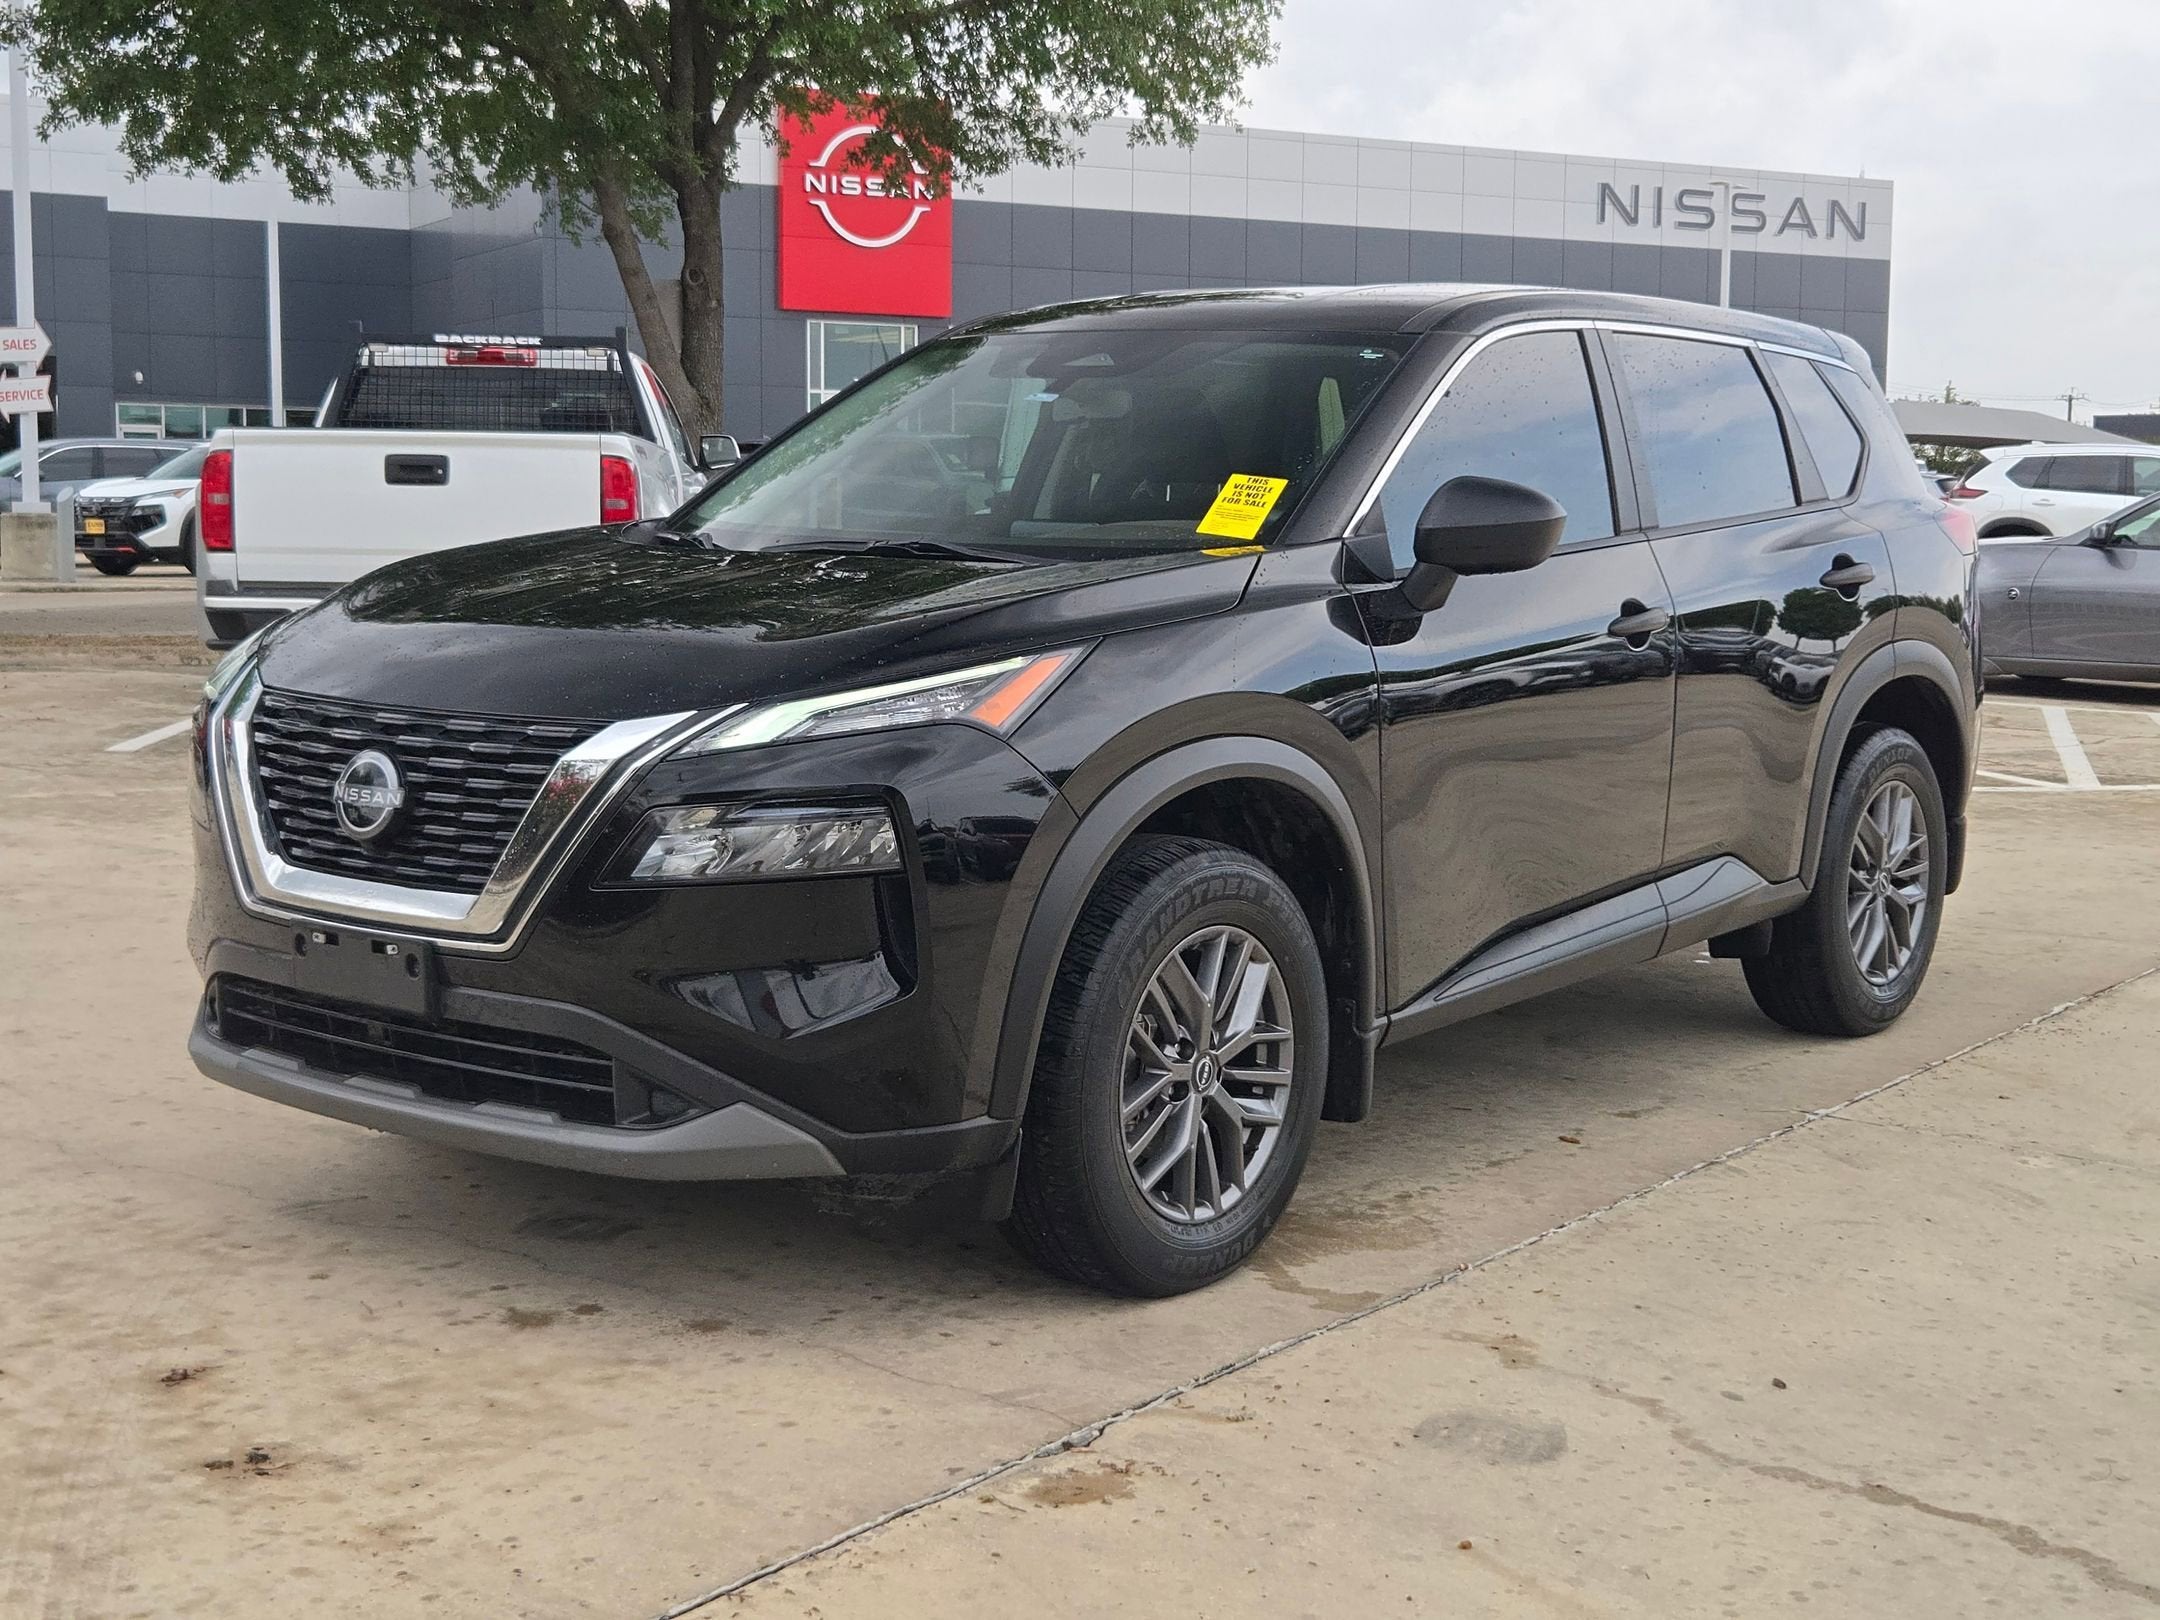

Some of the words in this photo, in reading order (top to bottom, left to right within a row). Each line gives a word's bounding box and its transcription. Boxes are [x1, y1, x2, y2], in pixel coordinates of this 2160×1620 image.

[1597, 181, 1867, 242] NISSAN
[2, 339, 37, 351] SALES
[434, 334, 543, 345] BACKRACK
[0, 389, 44, 402] SERVICE
[1247, 477, 1269, 486] THIS
[1233, 483, 1273, 494] VEHICLE
[1221, 496, 1242, 505] FOR
[1243, 499, 1267, 508] SALE
[1245, 492, 1266, 500] NOT
[334, 780, 402, 806] NISSAN
